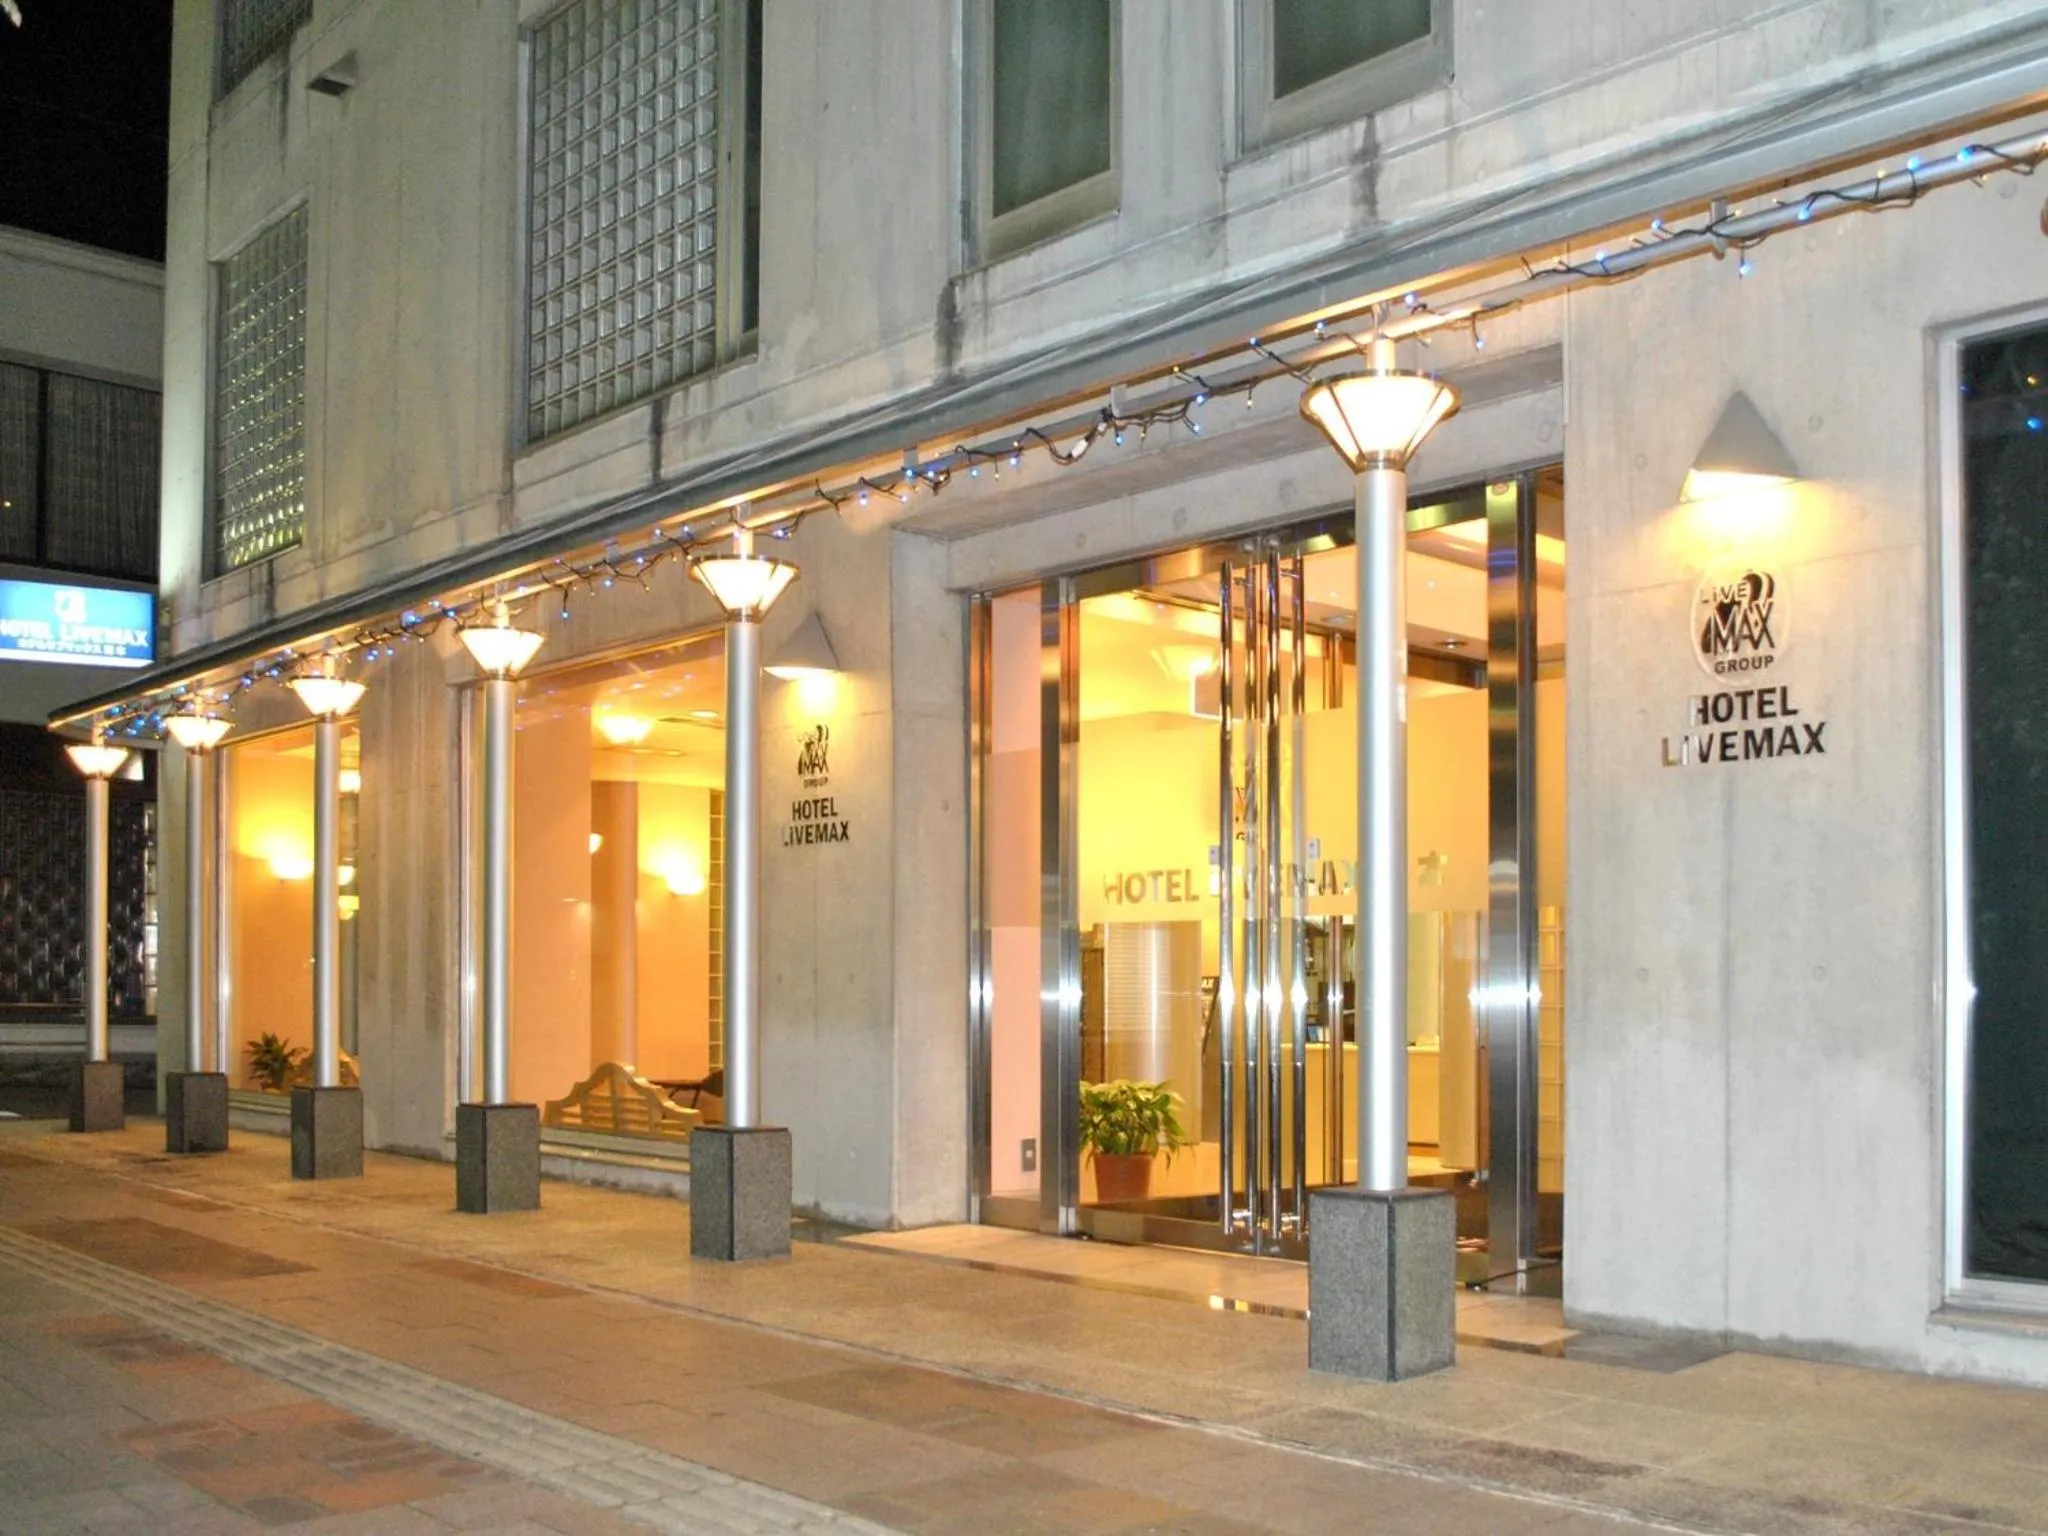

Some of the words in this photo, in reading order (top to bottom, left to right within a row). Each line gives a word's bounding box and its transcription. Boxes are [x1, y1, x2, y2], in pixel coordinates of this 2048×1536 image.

[1712, 600, 1776, 656] MAX
[1714, 655, 1775, 674] GROUP
[1690, 685, 1799, 727] HOTEL
[791, 796, 839, 821] HOTEL
[1103, 868, 1200, 905] HOTEL
